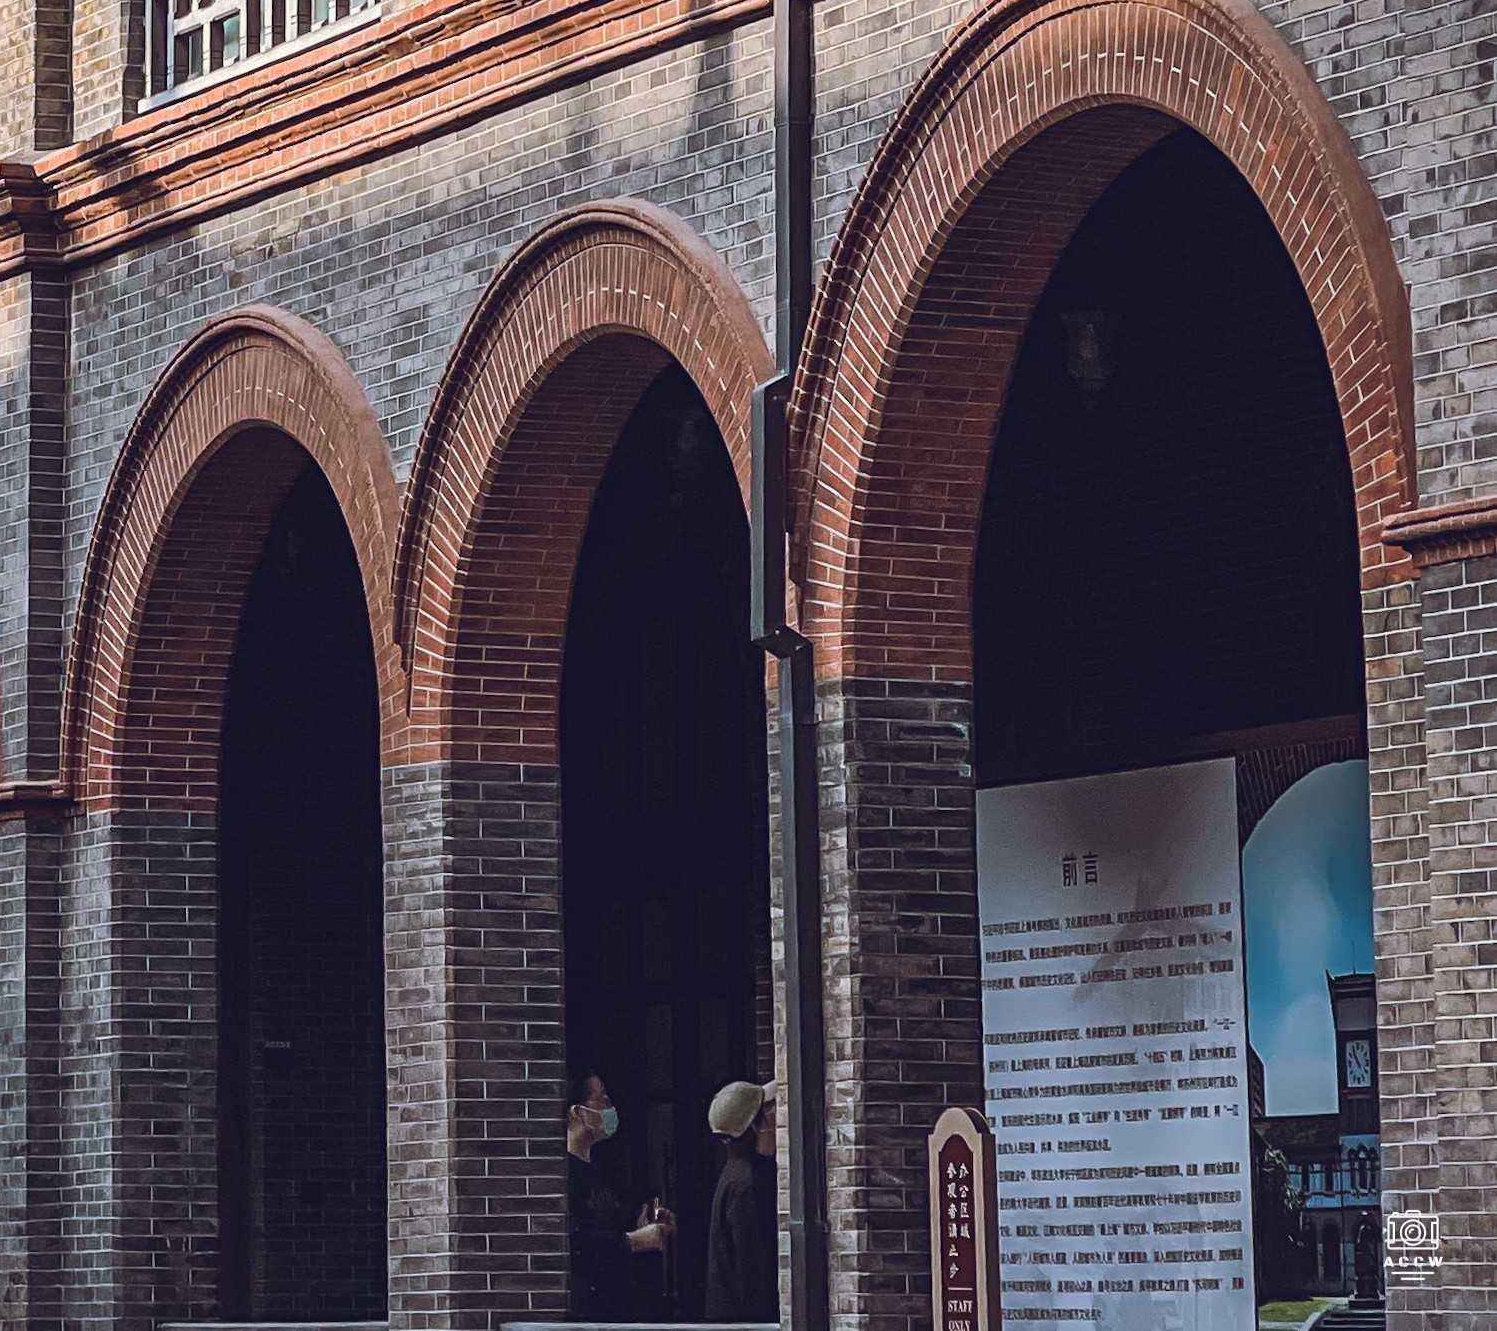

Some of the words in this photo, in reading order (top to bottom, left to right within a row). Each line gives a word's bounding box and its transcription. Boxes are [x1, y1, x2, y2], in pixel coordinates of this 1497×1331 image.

[1061, 850, 1099, 887] 前言
[947, 1299, 973, 1313] STAFF
[948, 1320, 971, 1331] ONLY
